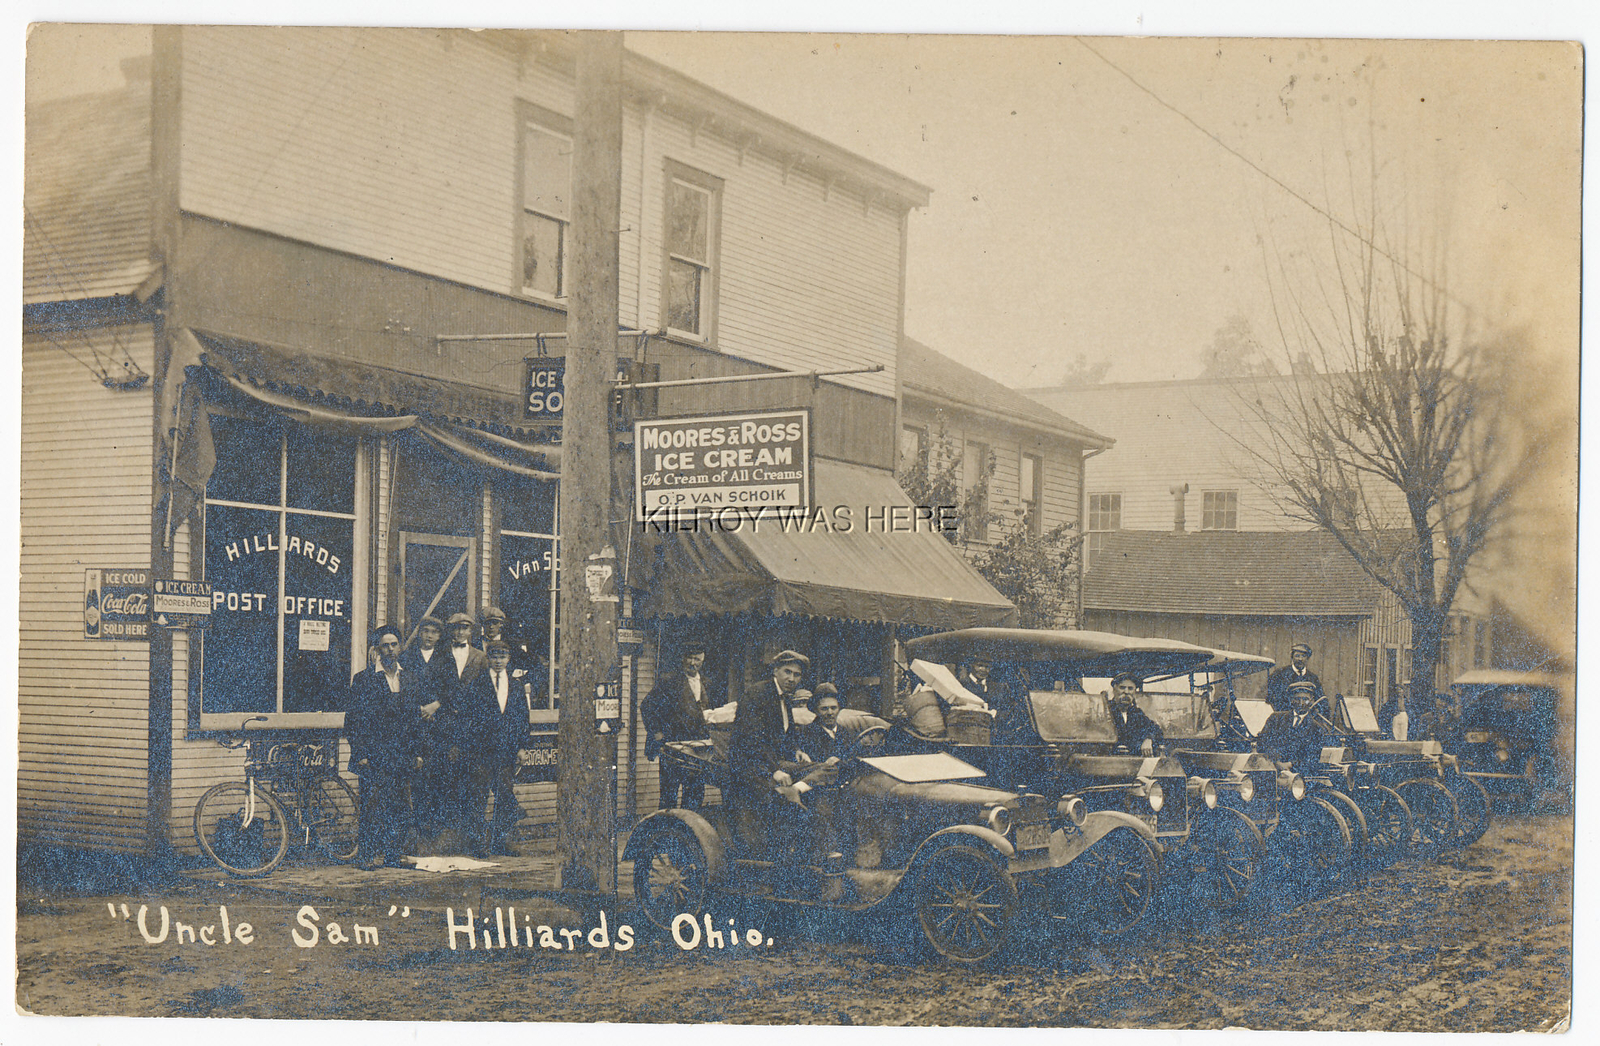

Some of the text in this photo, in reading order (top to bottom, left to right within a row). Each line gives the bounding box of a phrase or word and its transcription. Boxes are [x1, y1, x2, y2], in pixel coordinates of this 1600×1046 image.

[531, 371, 557, 388] ICE
[643, 427, 726, 450] MOORES
[741, 421, 801, 445] ROSS
[654, 447, 792, 472] ICE CREAM
[642, 468, 803, 486] The Cream of All Creams
[691, 491, 722, 504] VAN
[728, 489, 786, 503] SCHOIK
[225, 534, 341, 574] HILLIARDS
[105, 573, 146, 584] ICE COLD
[165, 581, 211, 595] ICE CREAM
[213, 591, 344, 616] POST OFFICE
[103, 624, 148, 636] SOLD HERE
